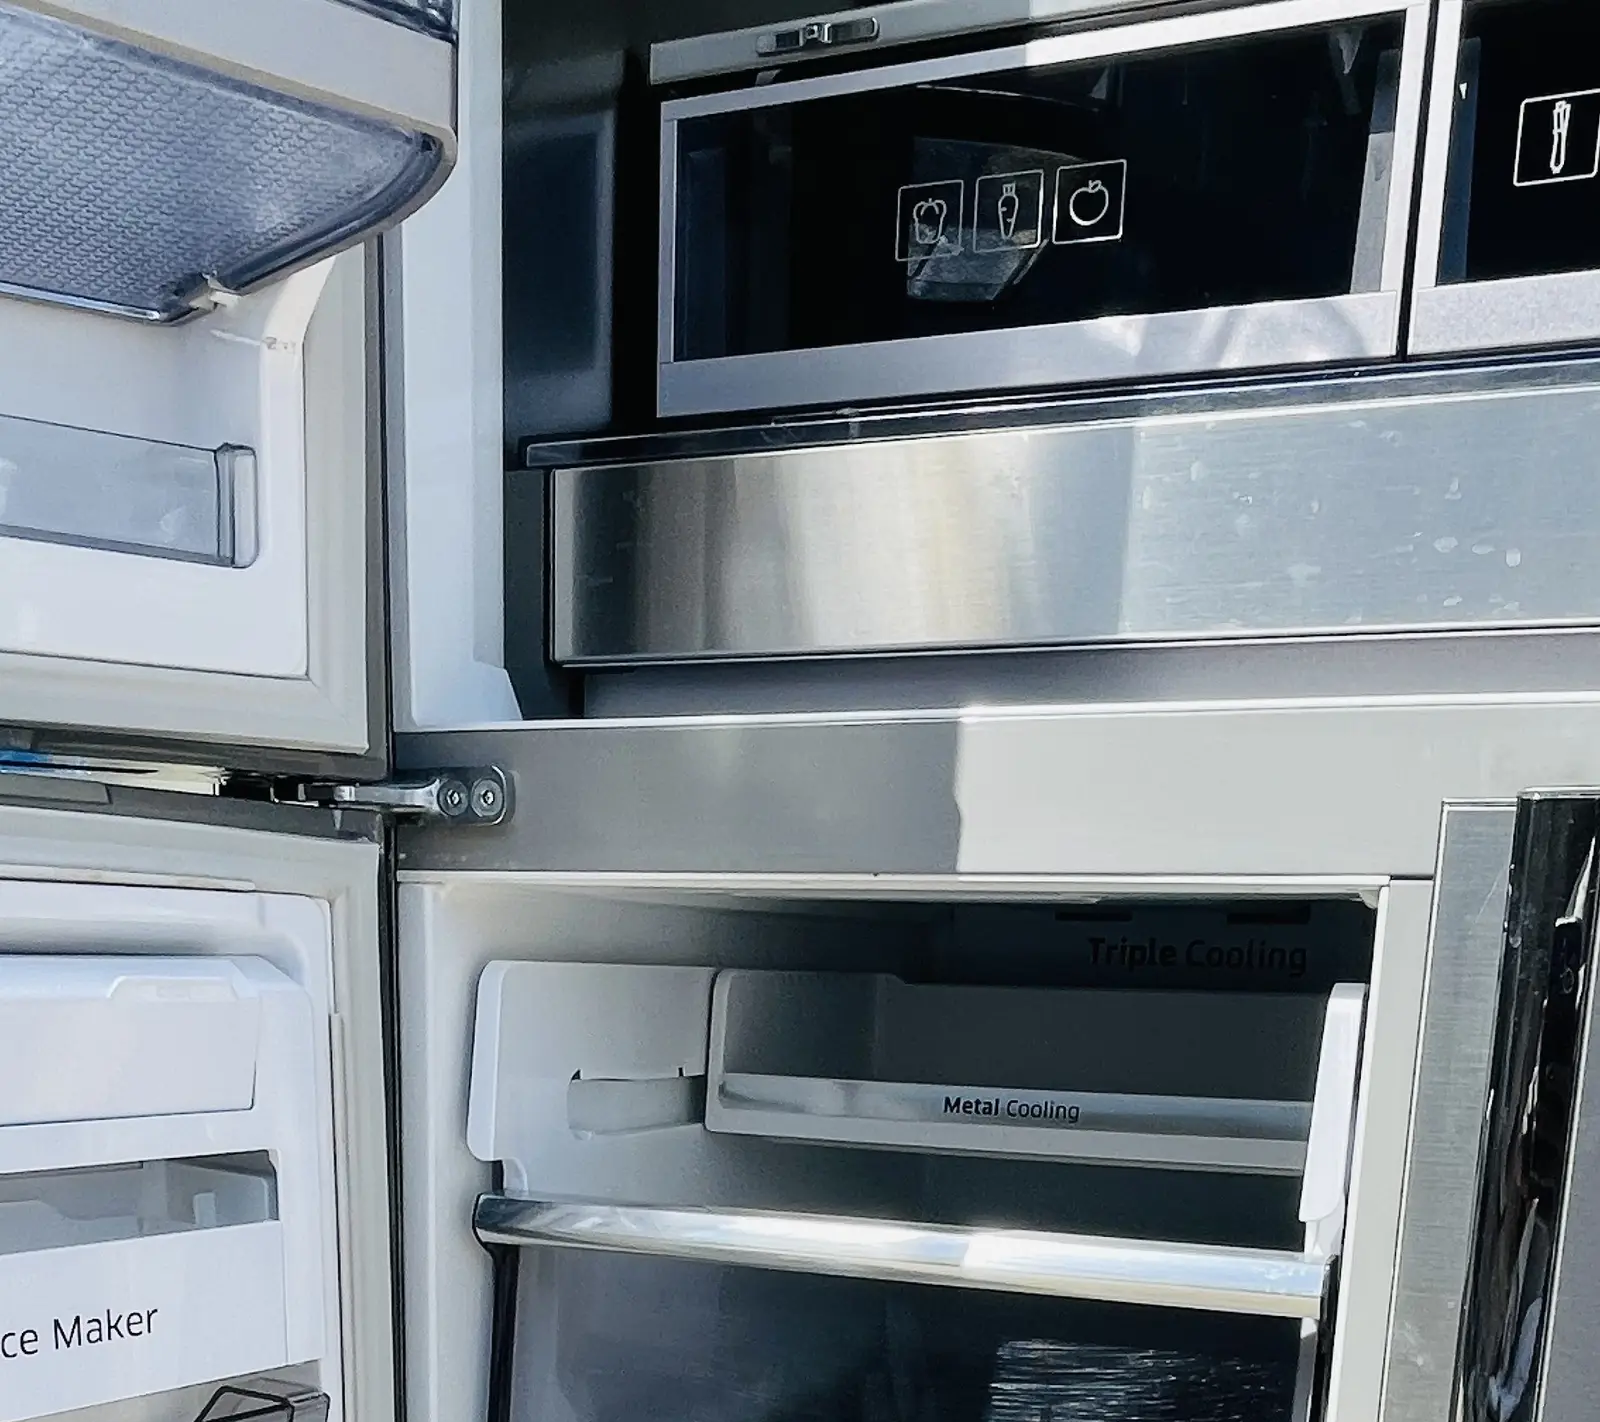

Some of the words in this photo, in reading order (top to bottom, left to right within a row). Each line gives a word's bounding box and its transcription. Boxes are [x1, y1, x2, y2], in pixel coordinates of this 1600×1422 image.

[1088, 936, 1178, 968] Triple
[1186, 938, 1307, 978] Cooling
[943, 1095, 999, 1117] Metal
[1006, 1098, 1081, 1124] Cooling
[0, 1327, 39, 1359] ce
[53, 1307, 159, 1350] Maker
